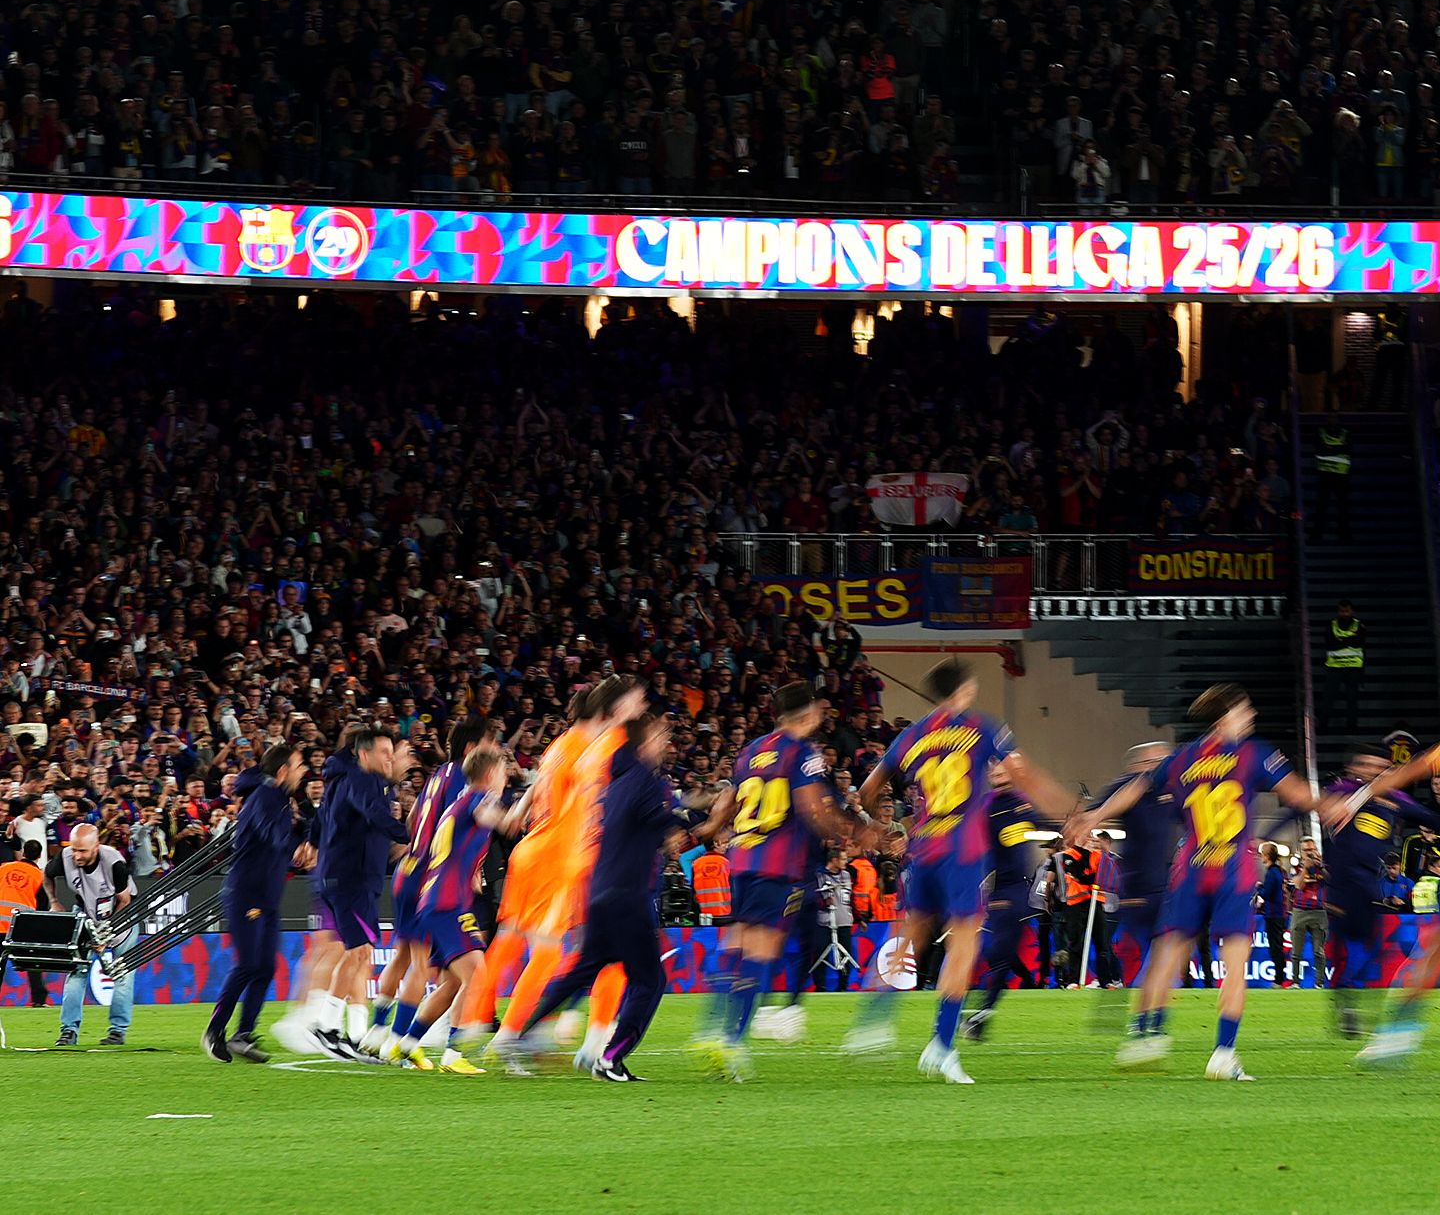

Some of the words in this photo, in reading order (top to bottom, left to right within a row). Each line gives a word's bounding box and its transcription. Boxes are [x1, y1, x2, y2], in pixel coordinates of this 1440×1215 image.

[615, 220, 921, 285] CAMPIONS
[930, 223, 996, 286] DE
[1001, 225, 1166, 288] LLIGA
[1172, 225, 1334, 287] 25/26
[1138, 545, 1276, 581] CONSTANTÍ
[65, 681, 128, 697] BARCELONA
[1189, 960, 1309, 981] AMBLIGHT
